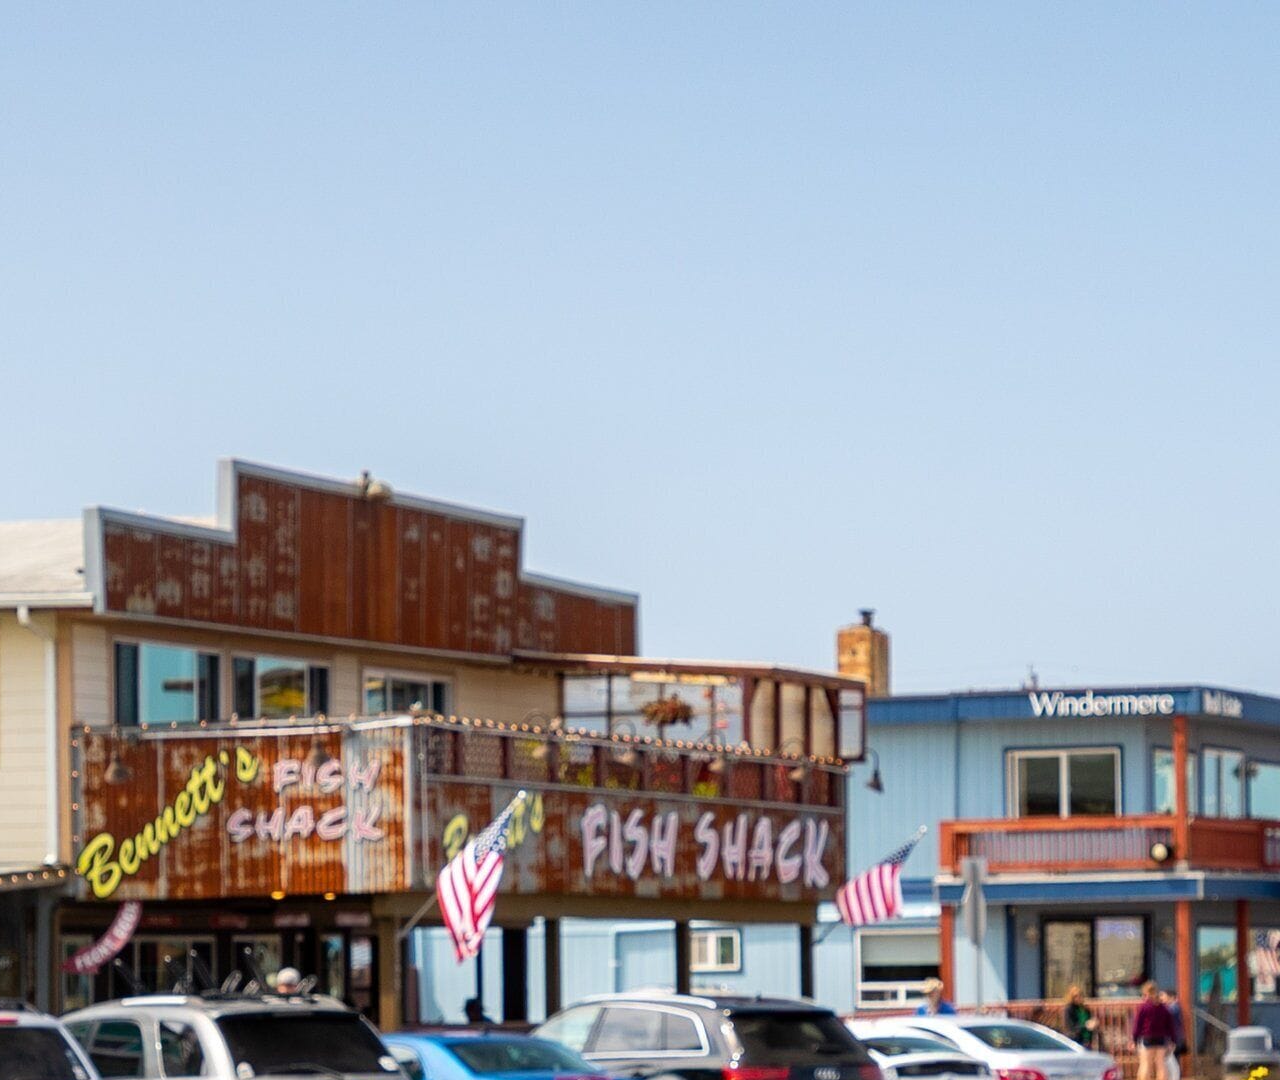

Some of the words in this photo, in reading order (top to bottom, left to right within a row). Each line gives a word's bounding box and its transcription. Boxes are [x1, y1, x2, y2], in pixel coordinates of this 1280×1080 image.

[1028, 689, 1174, 718] Windermere
[273, 758, 381, 794] FISH
[77, 745, 259, 899] Bennett's
[226, 804, 385, 843] SHACK
[581, 803, 680, 881] FISH
[694, 810, 830, 889] SHACK
